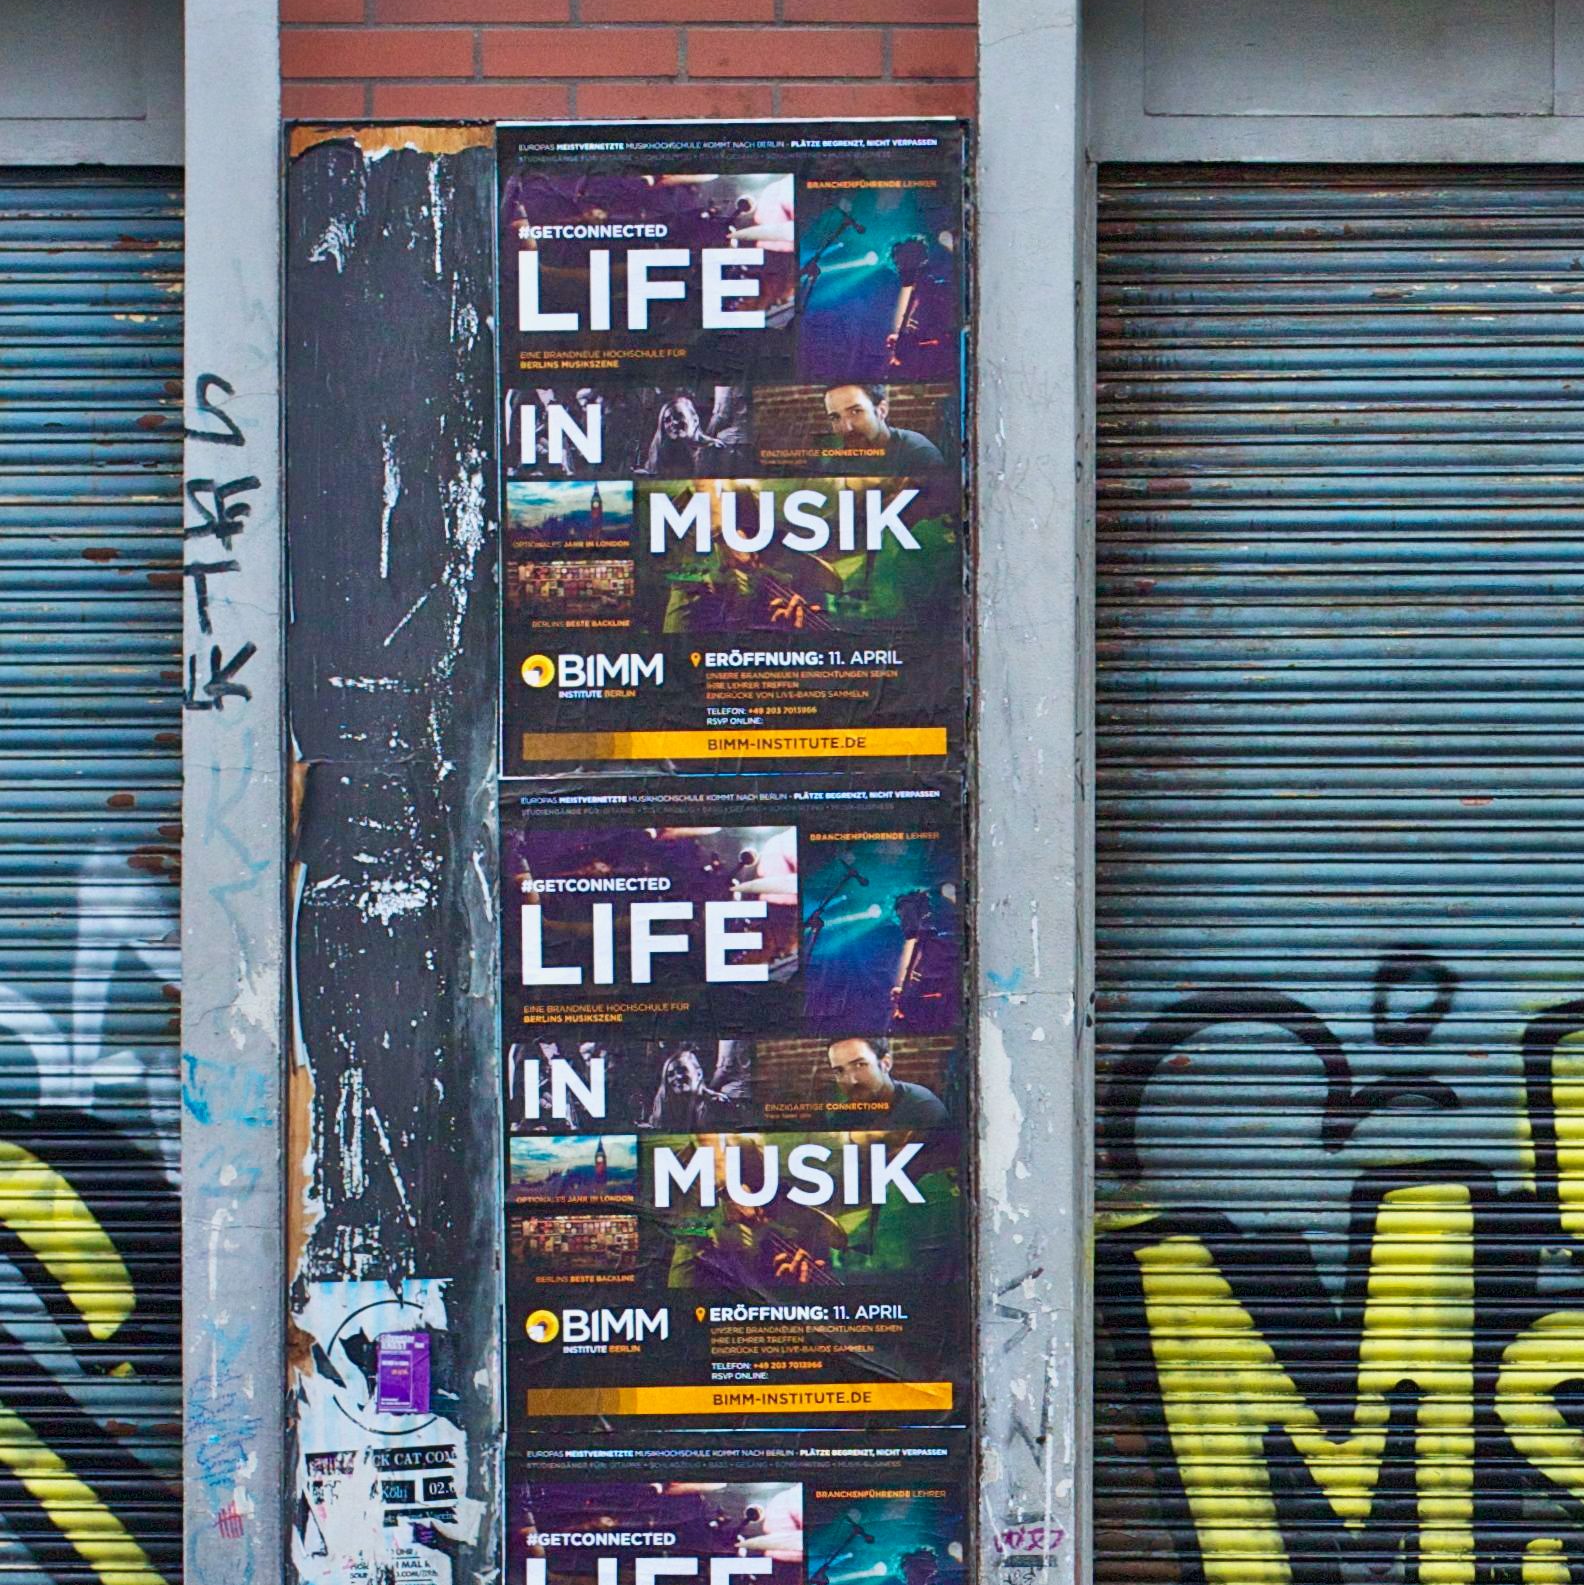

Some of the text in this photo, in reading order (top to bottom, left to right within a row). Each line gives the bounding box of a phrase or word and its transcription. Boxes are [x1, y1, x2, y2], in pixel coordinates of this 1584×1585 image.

[518, 224, 668, 239] #GETCONNECTED
[518, 247, 766, 331] LIFE
[519, 404, 602, 465] IN
[650, 488, 922, 553] MUSIK
[705, 649, 903, 666] ERÖFFNUNG: 11. APRIL
[558, 653, 664, 688] BIMM
[707, 736, 867, 751] BIMM-INSTITUTE.DE
[869, 790, 940, 800] NICHT VERPASSEN
[521, 877, 671, 893] #GETCONNECTED
[521, 900, 769, 985] LIFE
[523, 1014, 562, 1024] BERLINS
[523, 1058, 605, 1120] IN
[653, 1142, 926, 1208] MUSIK
[710, 1304, 908, 1321] ERÖFFNUNG: 11. APRIL
[563, 1308, 669, 1343] BIMM
[563, 1344, 607, 1355] INSTITUTE
[711, 1362, 751, 1371] TELEFON:
[713, 1391, 872, 1406] BIMM-INSTITUTE.DE
[394, 1452, 421, 1466] CAT
[800, 1447, 830, 1457] PLÄTZE
[832, 1448, 874, 1458] BEGRENZT,
[876, 1448, 900, 1457] NICHT
[902, 1448, 947, 1457] VERPASSEN
[816, 1489, 910, 1499] BRANCHENFÜHRENDE
[526, 1532, 676, 1546] #GETCONNECTED
